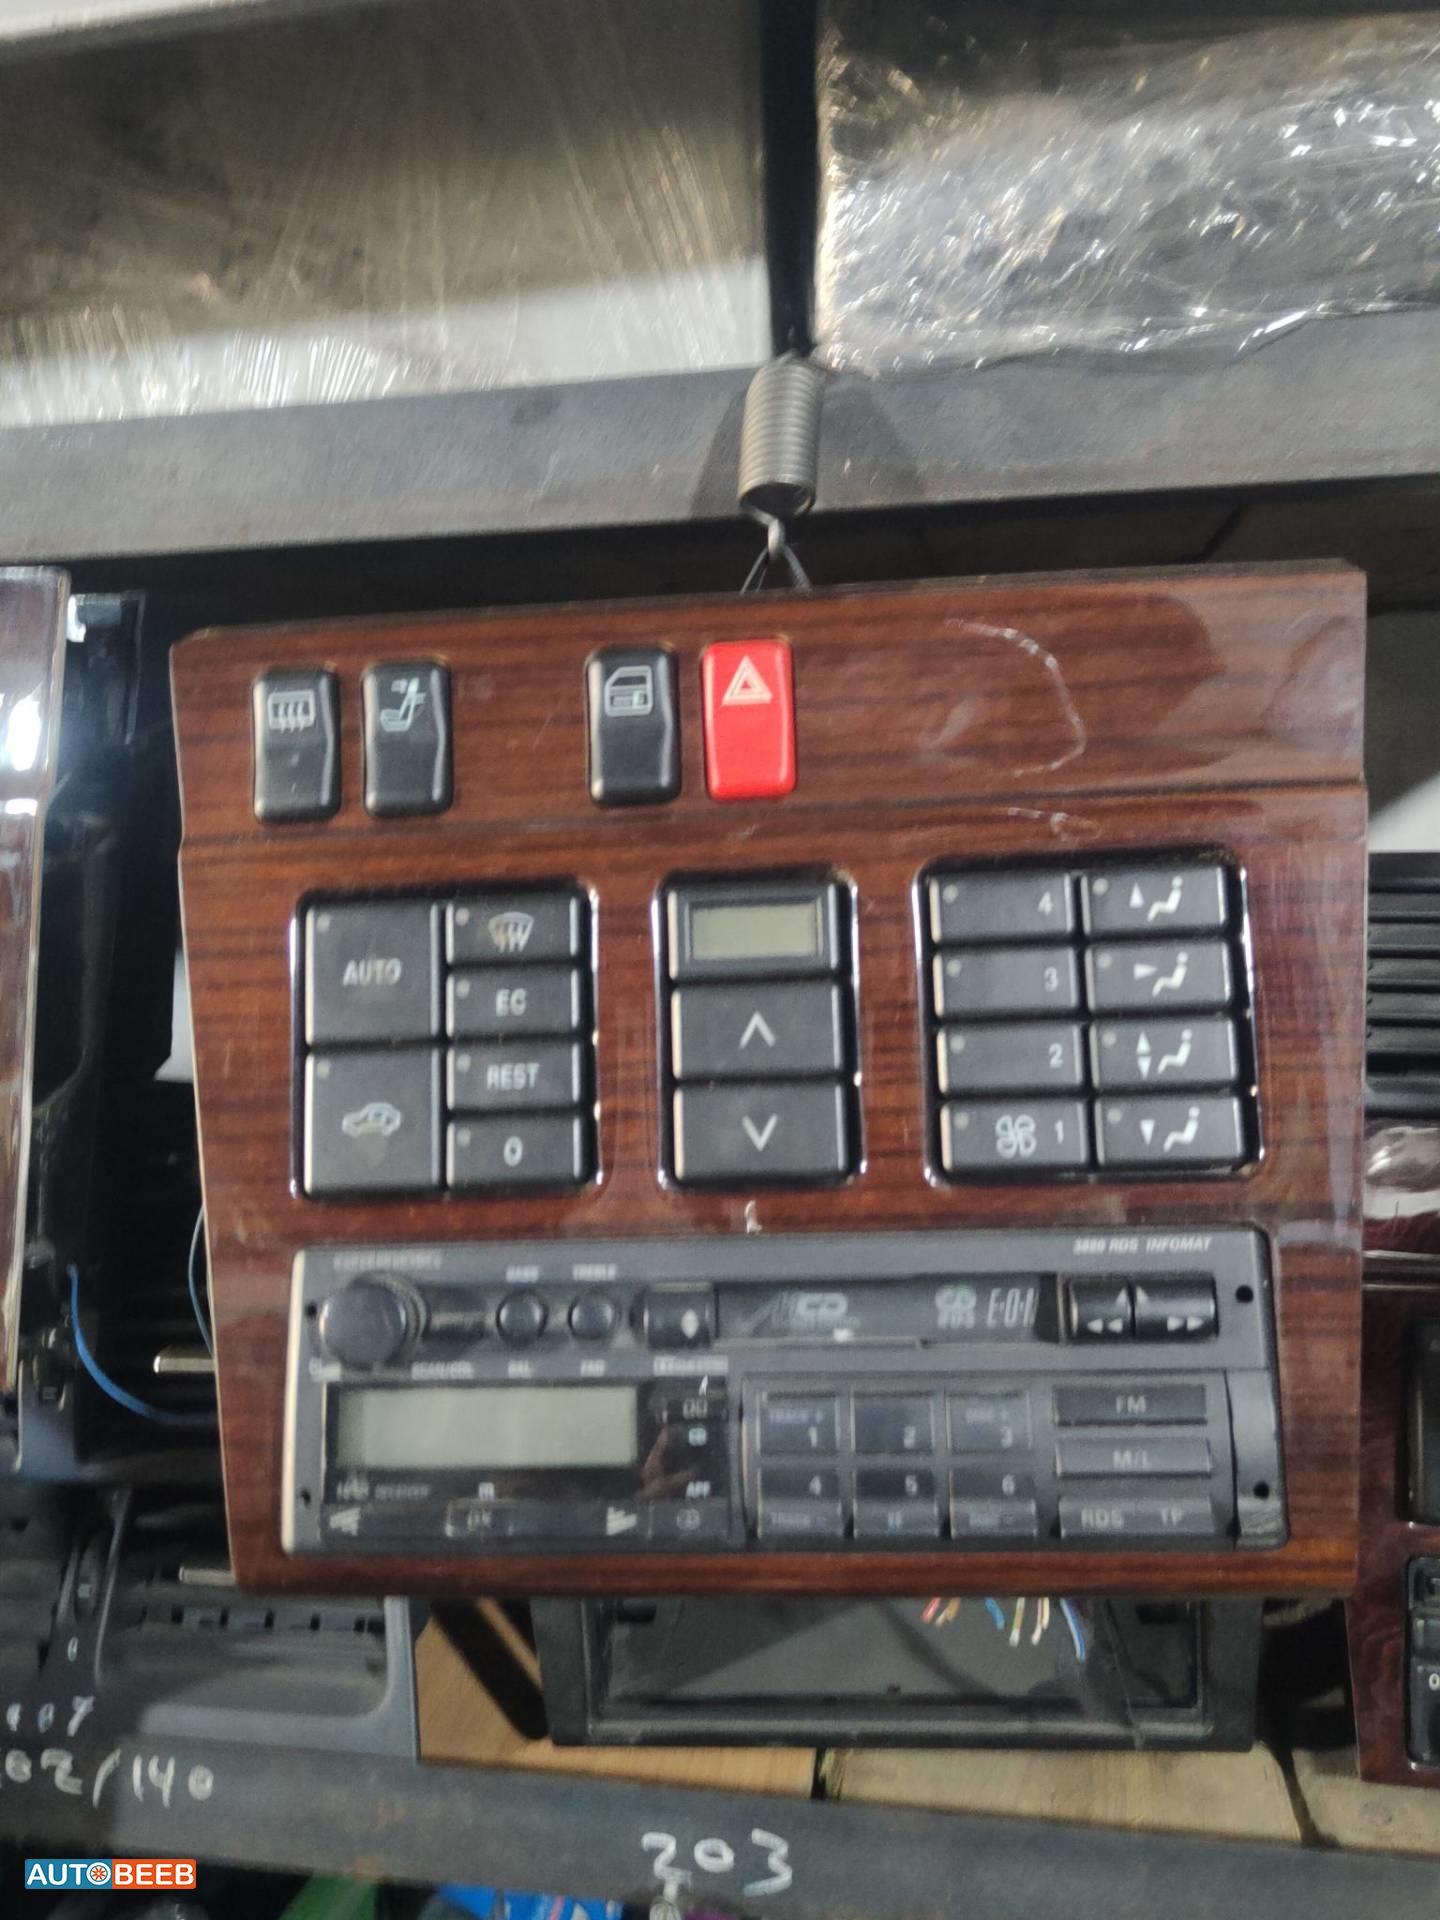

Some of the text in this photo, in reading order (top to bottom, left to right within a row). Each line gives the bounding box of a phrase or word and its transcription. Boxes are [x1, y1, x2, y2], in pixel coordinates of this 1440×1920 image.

[1038, 891, 1051, 916] 4
[342, 958, 402, 986] AUTO
[1044, 967, 1058, 992] 3
[1049, 1043, 1063, 1068] 2
[487, 1062, 539, 1089] REST
[1055, 1120, 1064, 1144] 1
[641, 1828, 793, 1896] 203
